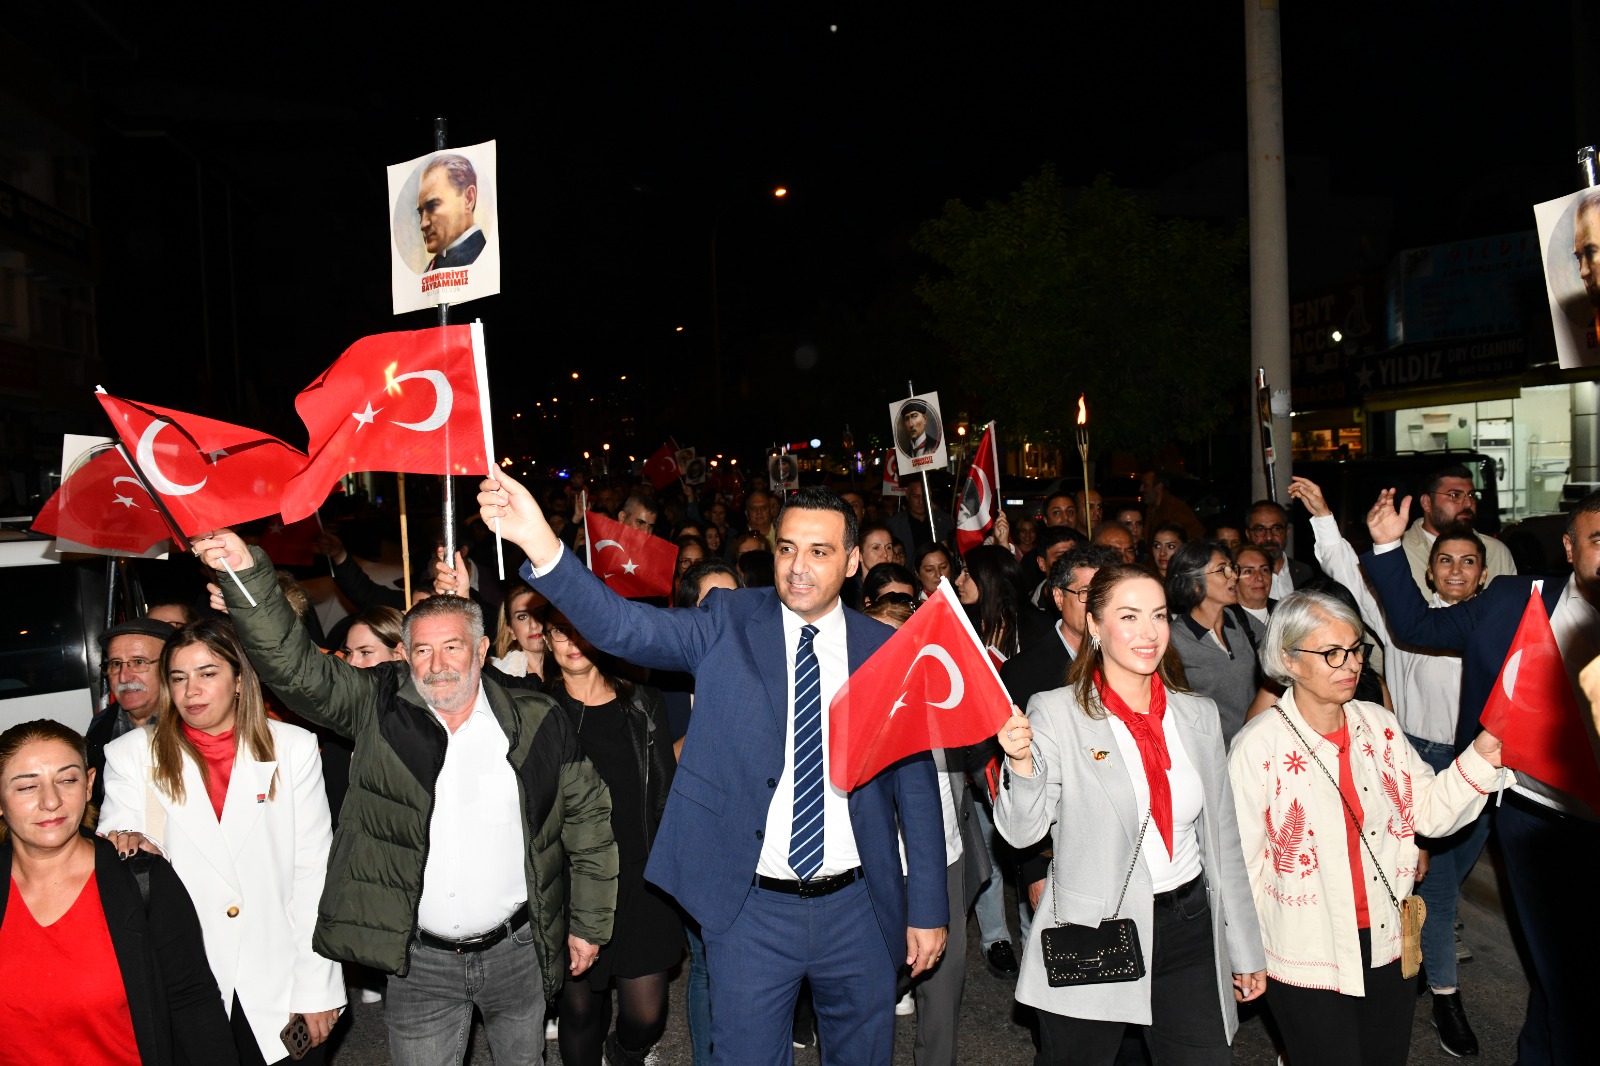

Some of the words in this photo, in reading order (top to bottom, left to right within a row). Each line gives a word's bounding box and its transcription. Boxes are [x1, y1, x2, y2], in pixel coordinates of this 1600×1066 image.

[421, 270, 469, 286] CUMHURİYET
[421, 277, 469, 293] BAYRAMIMIZ
[1292, 294, 1336, 328] ENT
[1293, 325, 1343, 354] ACCO
[1377, 350, 1443, 385] YILDIZ
[1448, 346, 1468, 363] DRY
[1470, 338, 1525, 359] CLEANING
